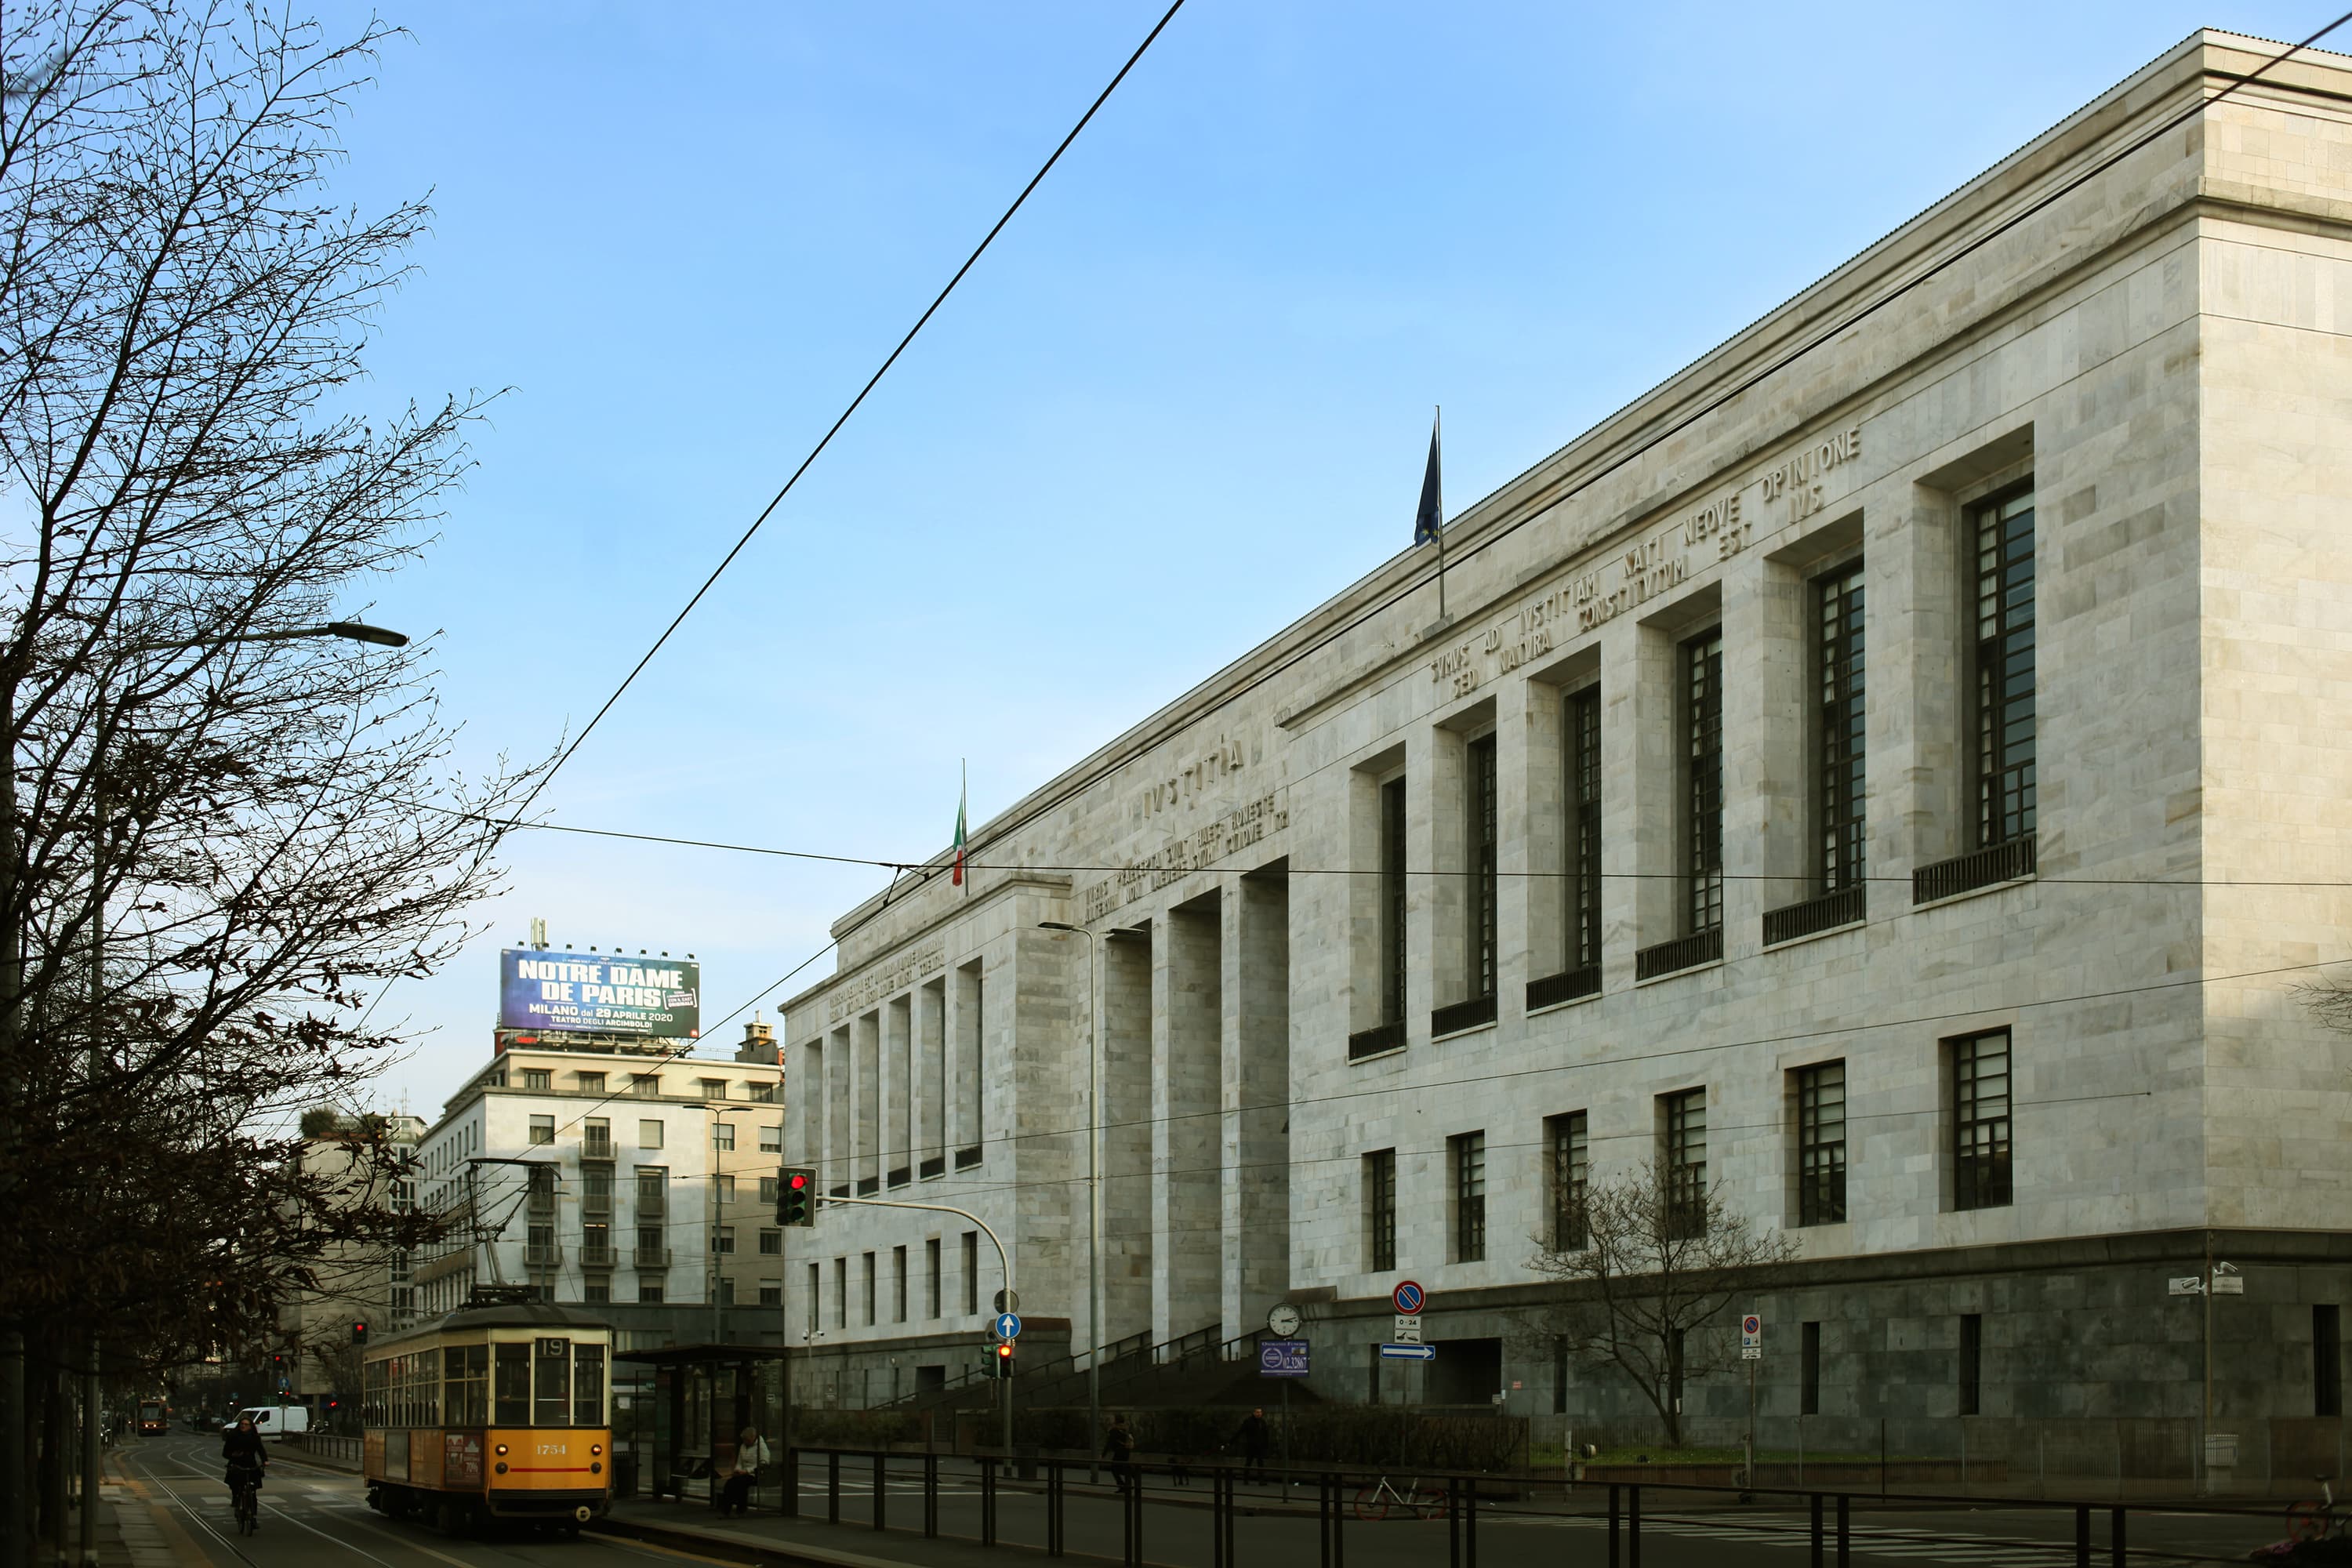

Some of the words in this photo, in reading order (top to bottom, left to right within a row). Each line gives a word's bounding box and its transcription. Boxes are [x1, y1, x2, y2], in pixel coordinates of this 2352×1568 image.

[1430, 645, 1469, 683] SVMVS
[1483, 628, 1502, 654] AD
[1623, 535, 1664, 579] NATI
[1762, 427, 1860, 503] OPINIONE
[1454, 666, 1479, 698] SED
[1718, 521, 1752, 561] EST
[1788, 485, 1825, 524] IVS
[1142, 739, 1244, 818] IVSTITIA
[519, 960, 601, 984] NOTRE
[610, 967, 683, 989] DAME
[541, 981, 574, 1002] DE
[582, 984, 662, 1007] PARIS
[529, 1004, 579, 1016] MILANO
[581, 1008, 593, 1018] dal
[595, 1007, 612, 1018] 29
[613, 1011, 647, 1021] APRILE
[649, 1013, 673, 1022] 2020
[551, 1015, 581, 1024] TEATRO
[583, 1017, 604, 1025] DEGLI
[605, 1018, 653, 1028] ARCIMBOLDI
[542, 1339, 564, 1356] 19
[536, 1444, 567, 1456] 1754
